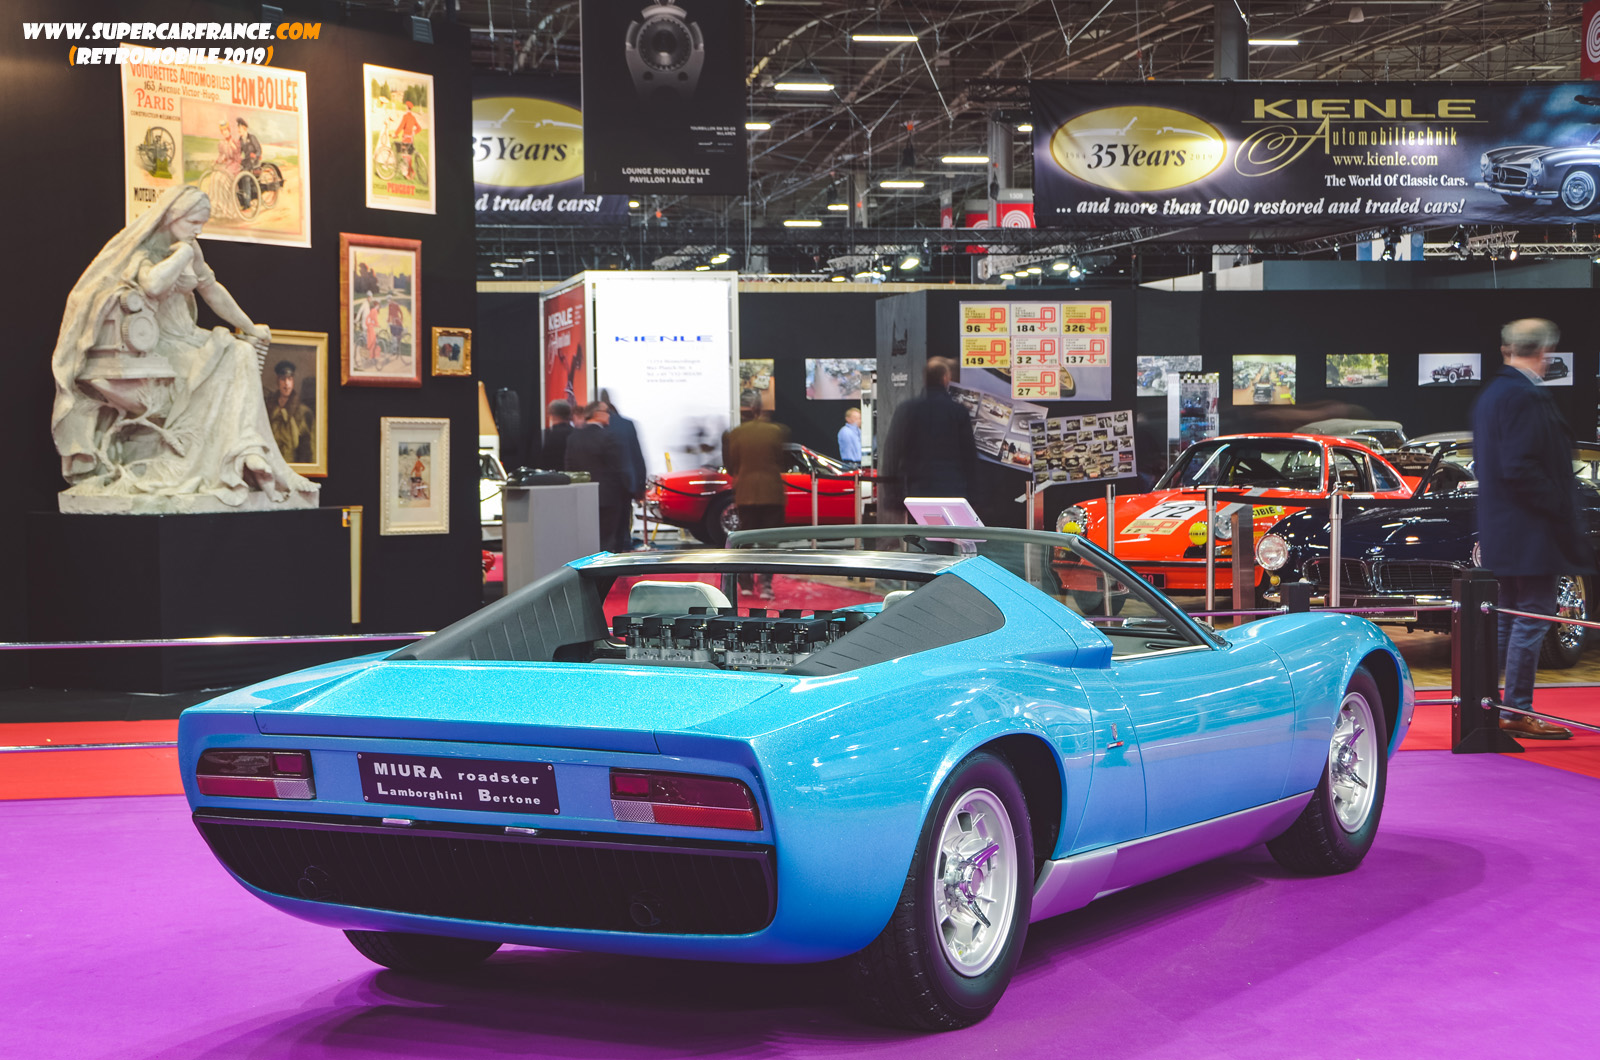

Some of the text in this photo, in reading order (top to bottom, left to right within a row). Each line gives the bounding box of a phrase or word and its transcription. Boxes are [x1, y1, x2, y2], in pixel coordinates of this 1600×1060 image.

[129, 62, 231, 91] VOITURETTES AUTOMOBILES
[258, 76, 298, 112] BOLLÉE
[1254, 99, 1476, 119] KIENLE
[496, 137, 568, 162] Years
[1234, 112, 1457, 177] Automobiltechnik
[1087, 143, 1118, 169] 35
[1120, 144, 1187, 167] Years
[1332, 152, 1439, 166] www.kienle.com
[622, 167, 652, 175] LOUNGE
[671, 175, 696, 184] ALLÉE
[1325, 174, 1469, 187] The World Of Classic Cars.
[492, 193, 555, 212] traded
[557, 195, 603, 212] cars!
[1076, 197, 1111, 214] and
[1113, 202, 1158, 214] more
[1162, 198, 1202, 215] than
[1206, 198, 1250, 214] 1000
[1253, 198, 1324, 215] restored
[1327, 198, 1361, 214] and
[1365, 198, 1422, 214] traded
[1423, 198, 1466, 214] cars!
[966, 325, 981, 333] 96
[1016, 325, 1035, 333] 184
[1064, 324, 1086, 332] 326
[965, 357, 985, 365] 149
[1016, 356, 1032, 364] 32
[1017, 388, 1031, 396] 27
[1150, 506, 1195, 518] 72
[373, 762, 539, 785] MIURA roadster
[377, 782, 541, 805] Lamborghini Bertone
